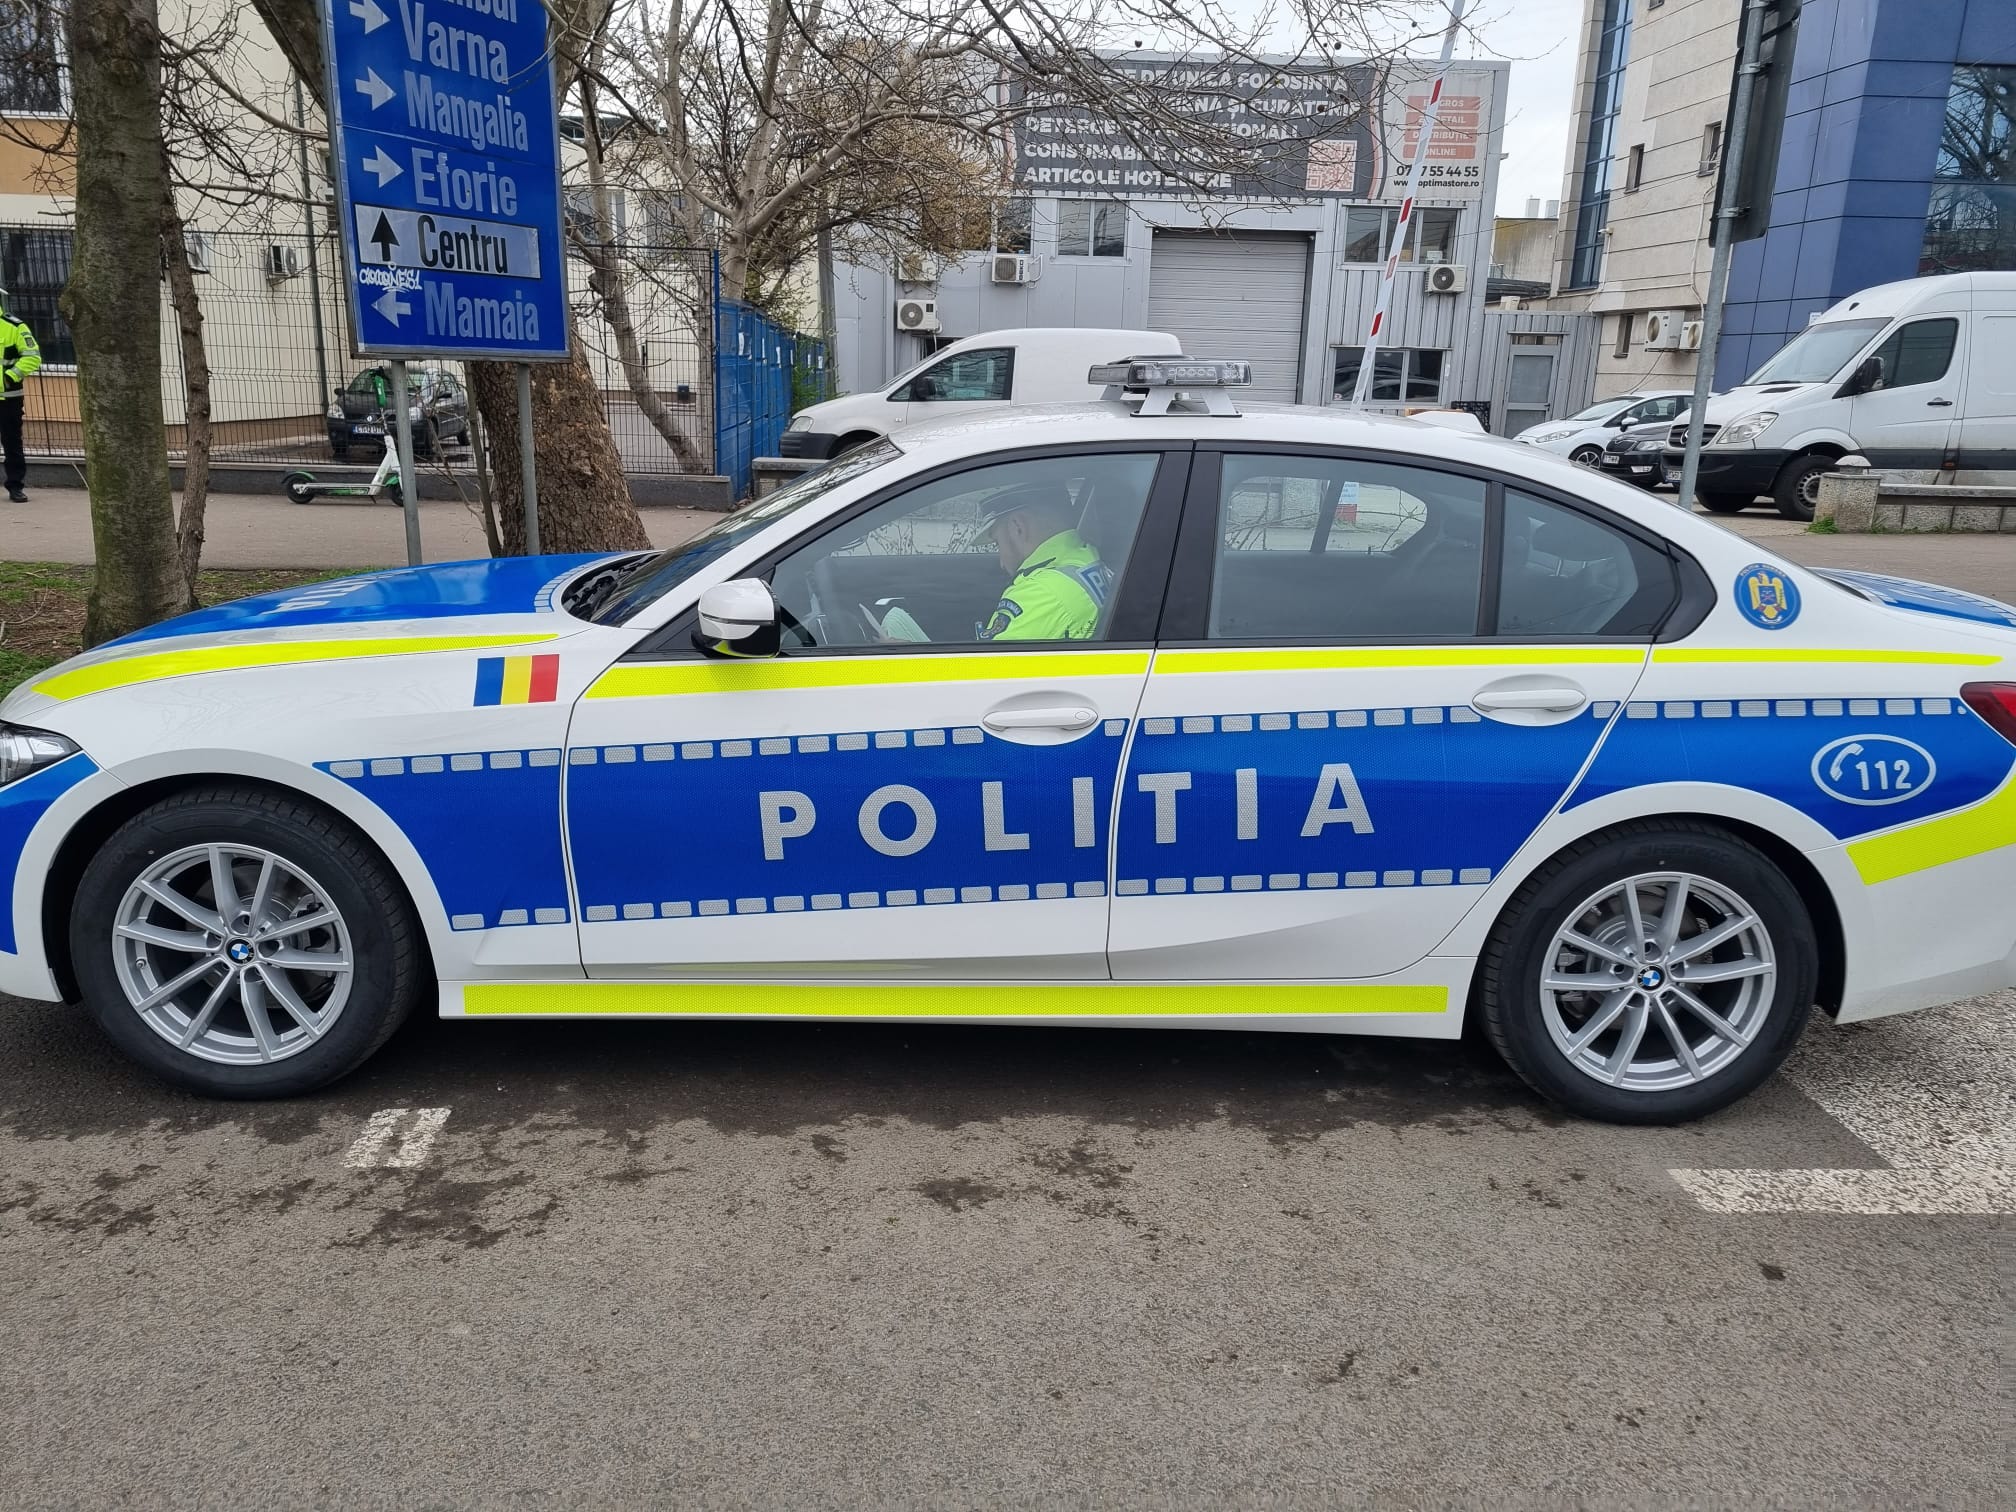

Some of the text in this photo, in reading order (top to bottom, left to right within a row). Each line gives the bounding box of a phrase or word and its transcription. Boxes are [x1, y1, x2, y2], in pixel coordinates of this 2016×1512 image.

[400, 2, 509, 85] Varna
[403, 70, 529, 152] Mangalia
[411, 146, 518, 216] Eforie
[1023, 166, 1120, 185] ARTICOLE
[1393, 179, 1480, 188] wwoptimastore.ro
[1396, 165, 1479, 177] 077 55 44 55
[417, 215, 509, 275] Centru
[423, 280, 540, 342] Mamaia
[1855, 759, 1912, 791] 112
[758, 762, 1375, 862] POLITIA
